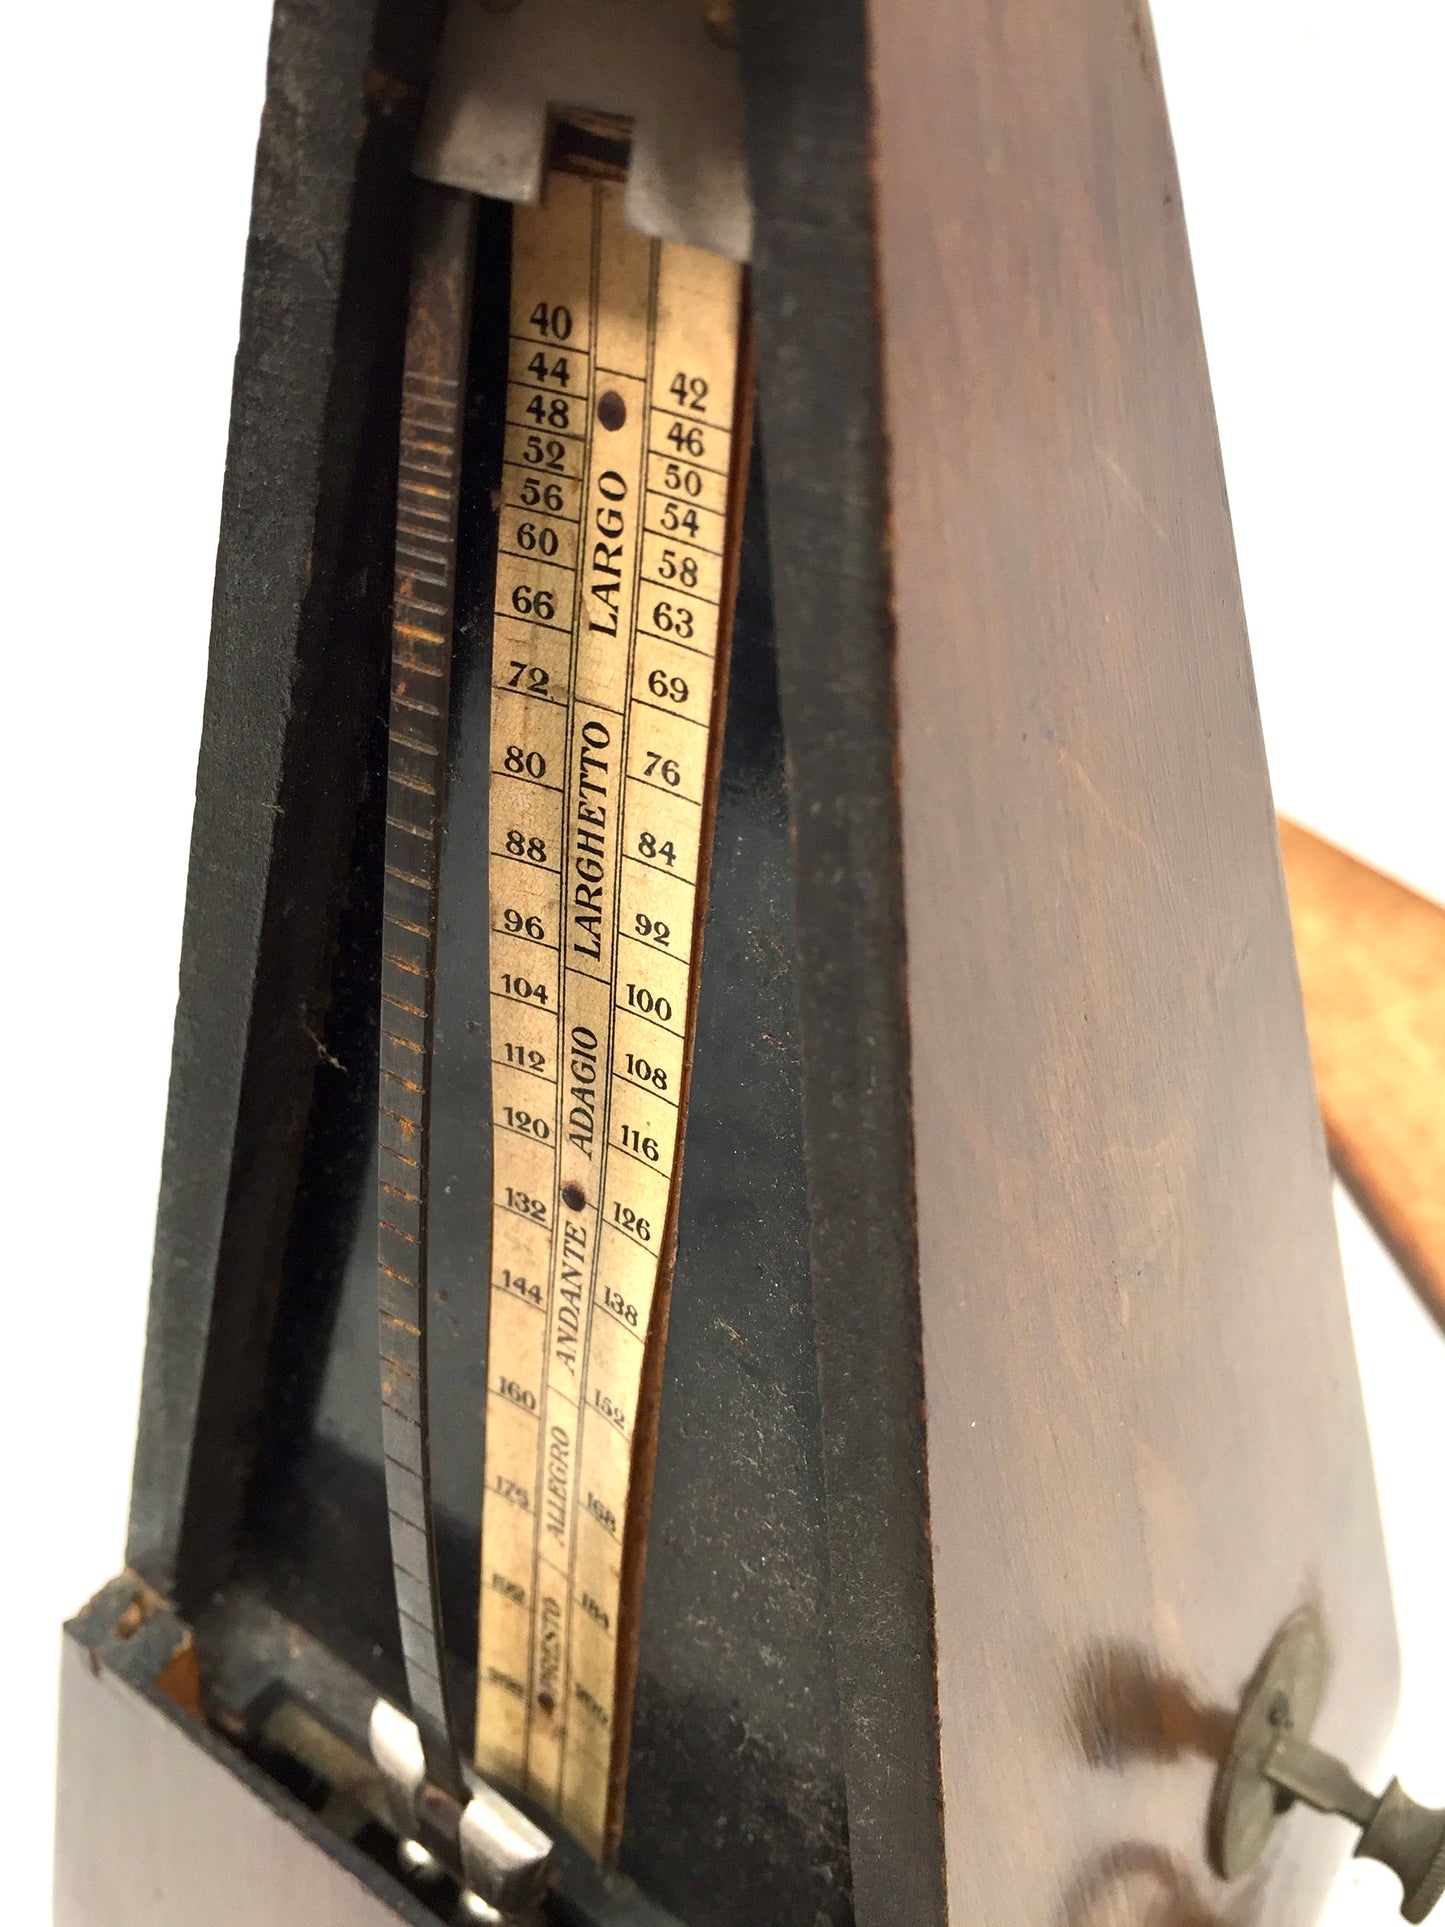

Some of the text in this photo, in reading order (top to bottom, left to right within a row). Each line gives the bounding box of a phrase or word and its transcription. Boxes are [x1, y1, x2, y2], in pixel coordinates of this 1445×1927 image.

[529, 302, 573, 341] 40
[528, 352, 570, 388] 44
[669, 371, 709, 413] 42
[526, 394, 569, 429] 48
[523, 436, 566, 471] 52
[667, 422, 705, 457] 46
[520, 477, 564, 512] 56
[664, 464, 703, 497] 50
[660, 503, 700, 537] 54
[517, 523, 559, 556] 60
[589, 470, 628, 638] LARGO
[658, 550, 698, 588] 58
[511, 585, 555, 620] 66
[653, 602, 694, 639] 63
[506, 661, 550, 697] 72
[648, 669, 689, 703] 69
[503, 745, 547, 779] 80
[642, 751, 681, 787] 76
[505, 830, 547, 864] 88
[573, 721, 611, 962] LARGHETTO
[638, 831, 677, 867] 84
[503, 908, 545, 940] 96
[634, 913, 670, 947] 92
[500, 973, 549, 1005] 104
[625, 984, 673, 1022] 100
[504, 1042, 546, 1073] 112
[625, 1053, 668, 1091] 108
[567, 1025, 599, 1161] ADAGIO
[503, 1107, 550, 1140] 120
[621, 1124, 660, 1163] 116
[504, 1187, 548, 1222] 132
[613, 1201, 651, 1242] 126
[501, 1269, 543, 1305] 144
[556, 1220, 588, 1376] ANDANTE
[603, 1285, 639, 1327] 138
[498, 1375, 536, 1411] 160
[593, 1388, 627, 1431] 152
[546, 1425, 571, 1548] ALLEGRO
